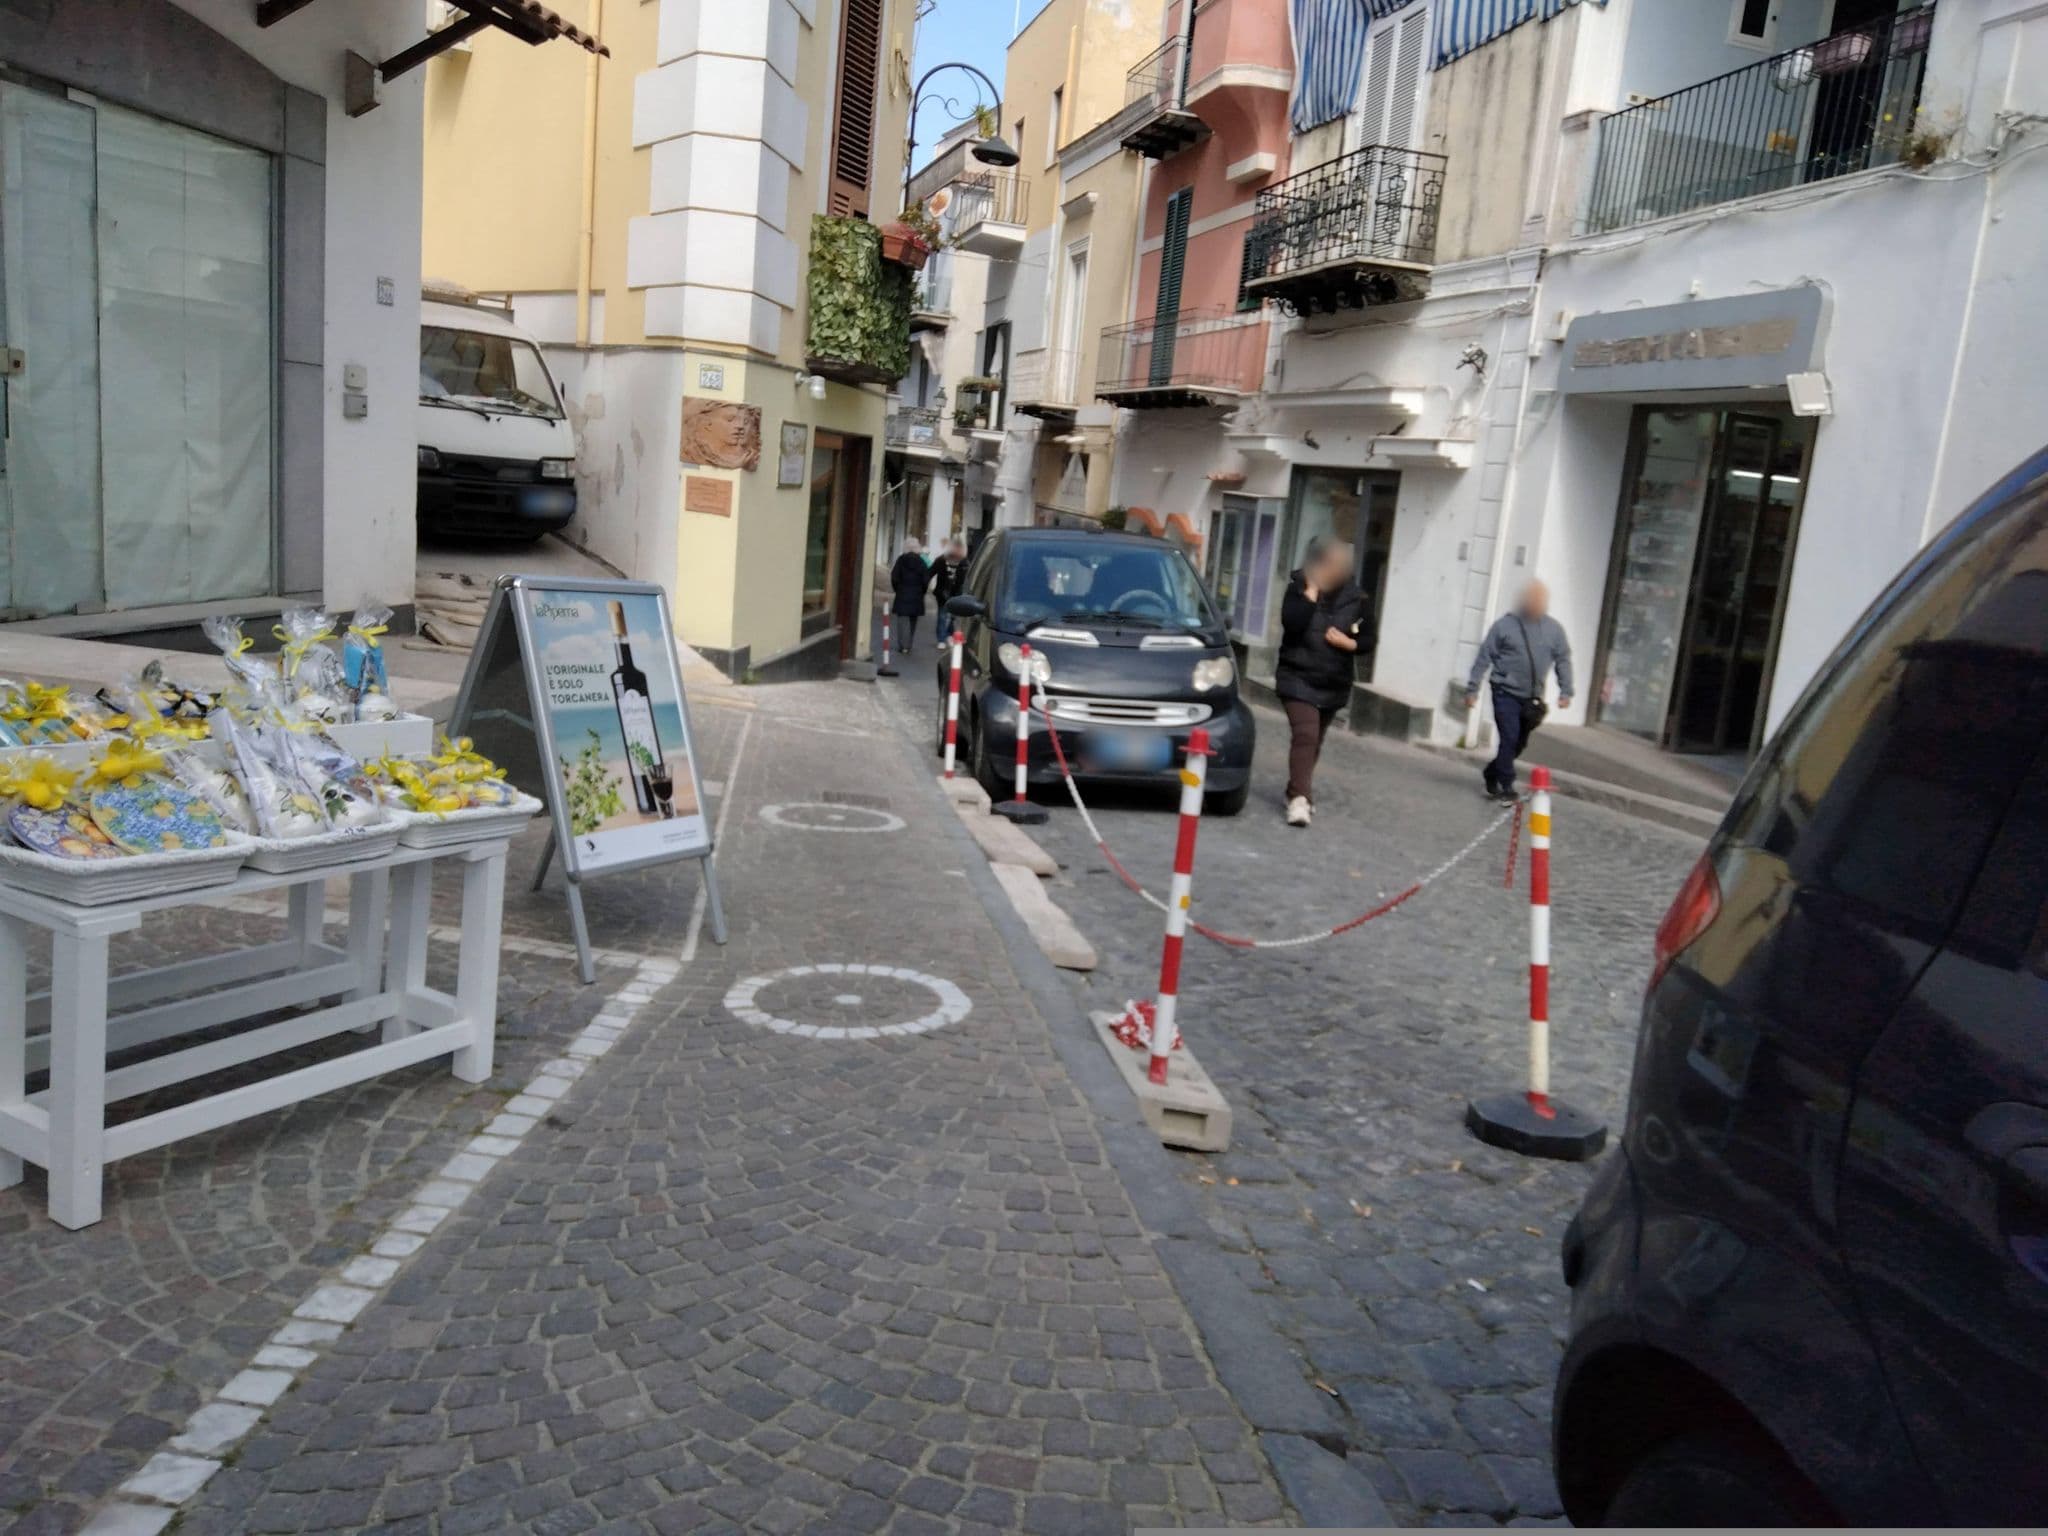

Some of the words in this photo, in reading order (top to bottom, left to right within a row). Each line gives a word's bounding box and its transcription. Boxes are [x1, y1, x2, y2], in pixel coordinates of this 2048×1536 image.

[546, 664, 605, 676] L'ORIGINALE
[557, 679, 583, 689] SOLO
[551, 692, 610, 704] TORCANERA
